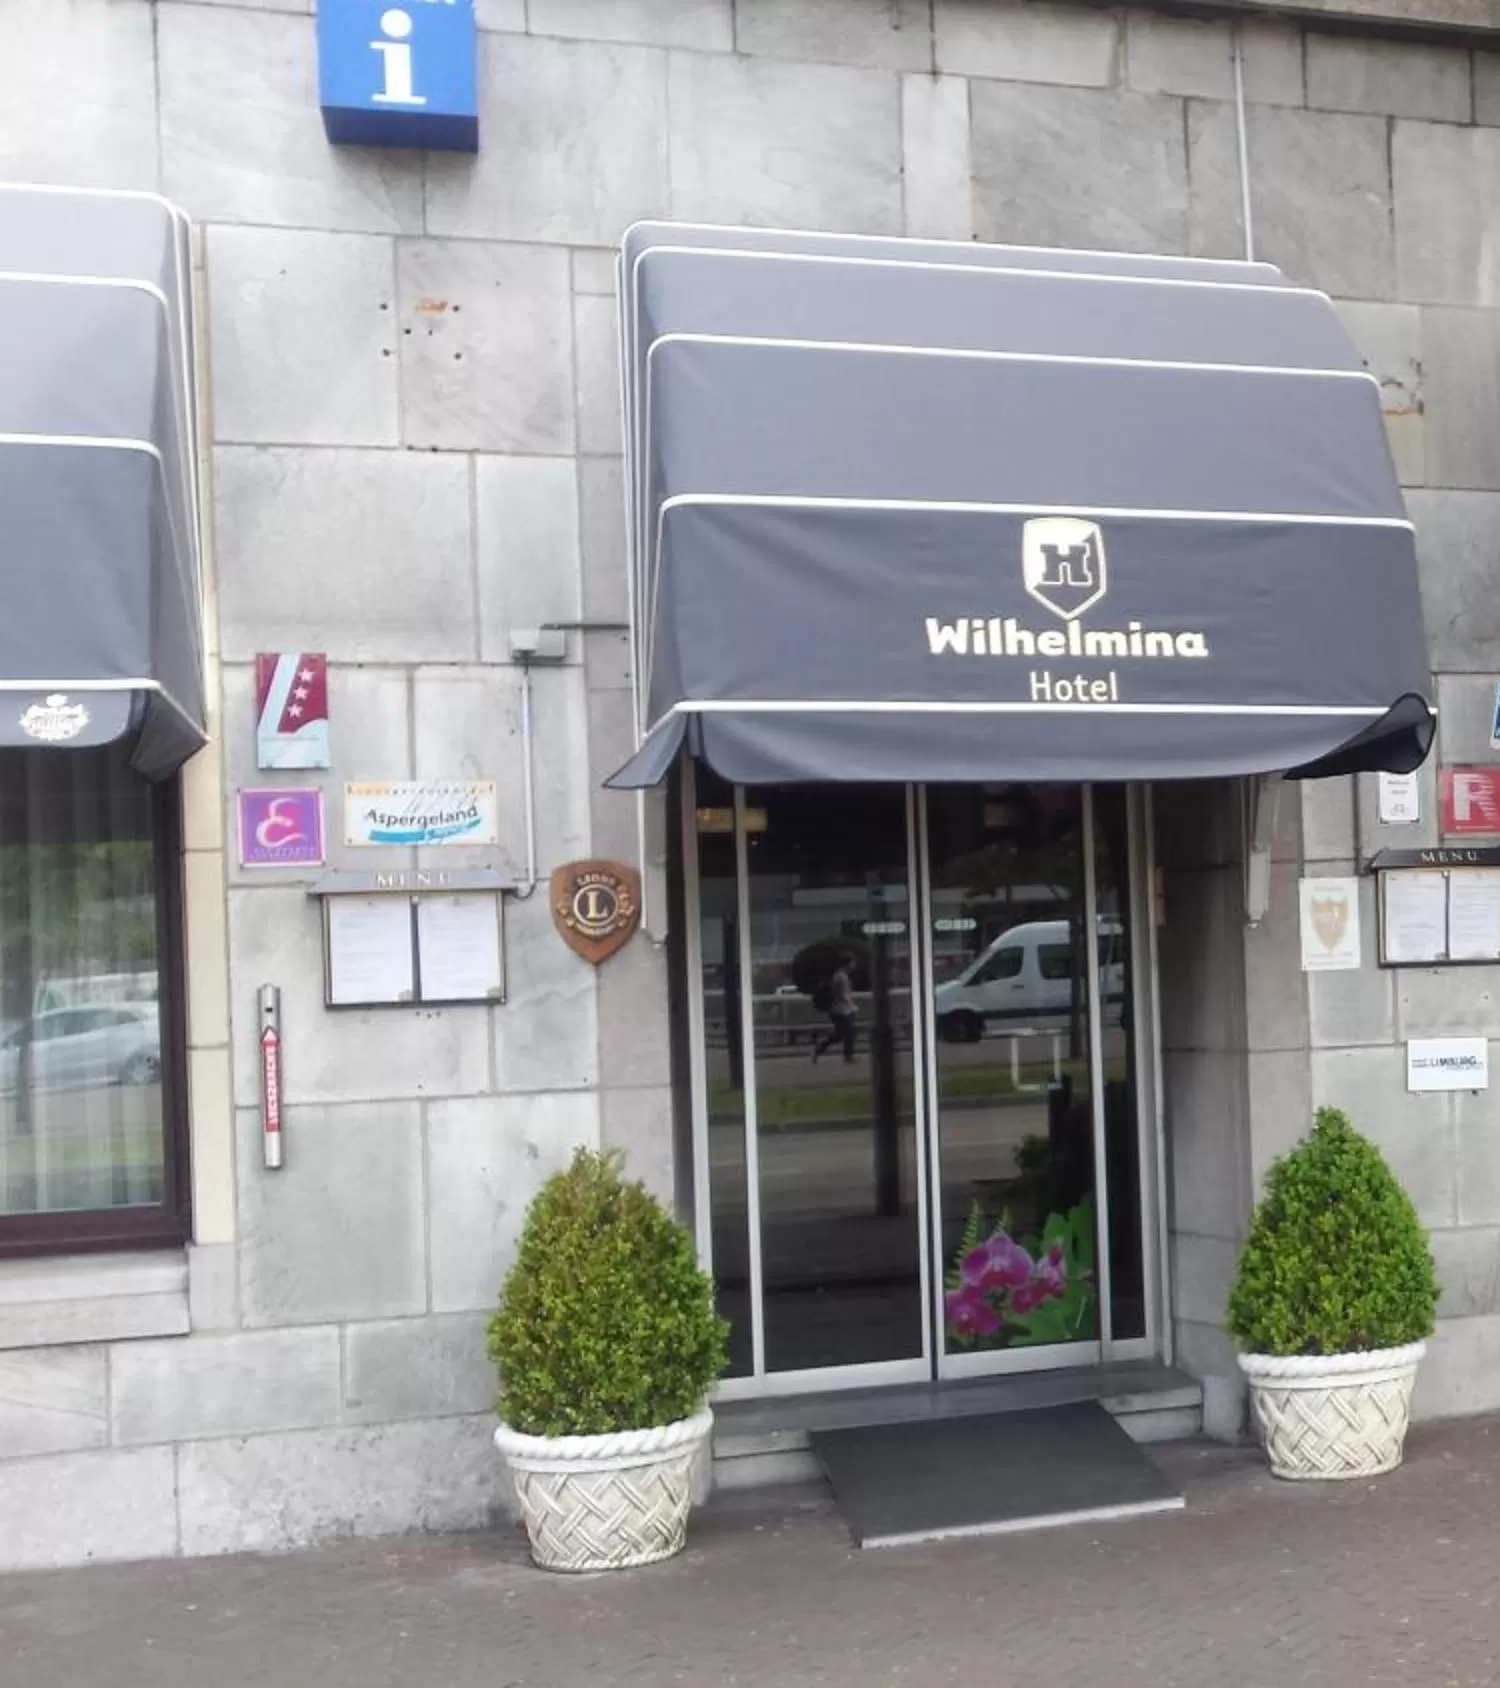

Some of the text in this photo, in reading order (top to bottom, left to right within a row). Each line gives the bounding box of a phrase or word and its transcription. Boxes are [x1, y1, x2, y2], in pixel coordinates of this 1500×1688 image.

[368, 8, 428, 105] i
[925, 616, 1209, 657] Wilhelmina
[1029, 671, 1119, 701] Hotel
[365, 804, 479, 829] Aspergeland
[1421, 850, 1477, 862] MENU
[586, 891, 608, 919] L
